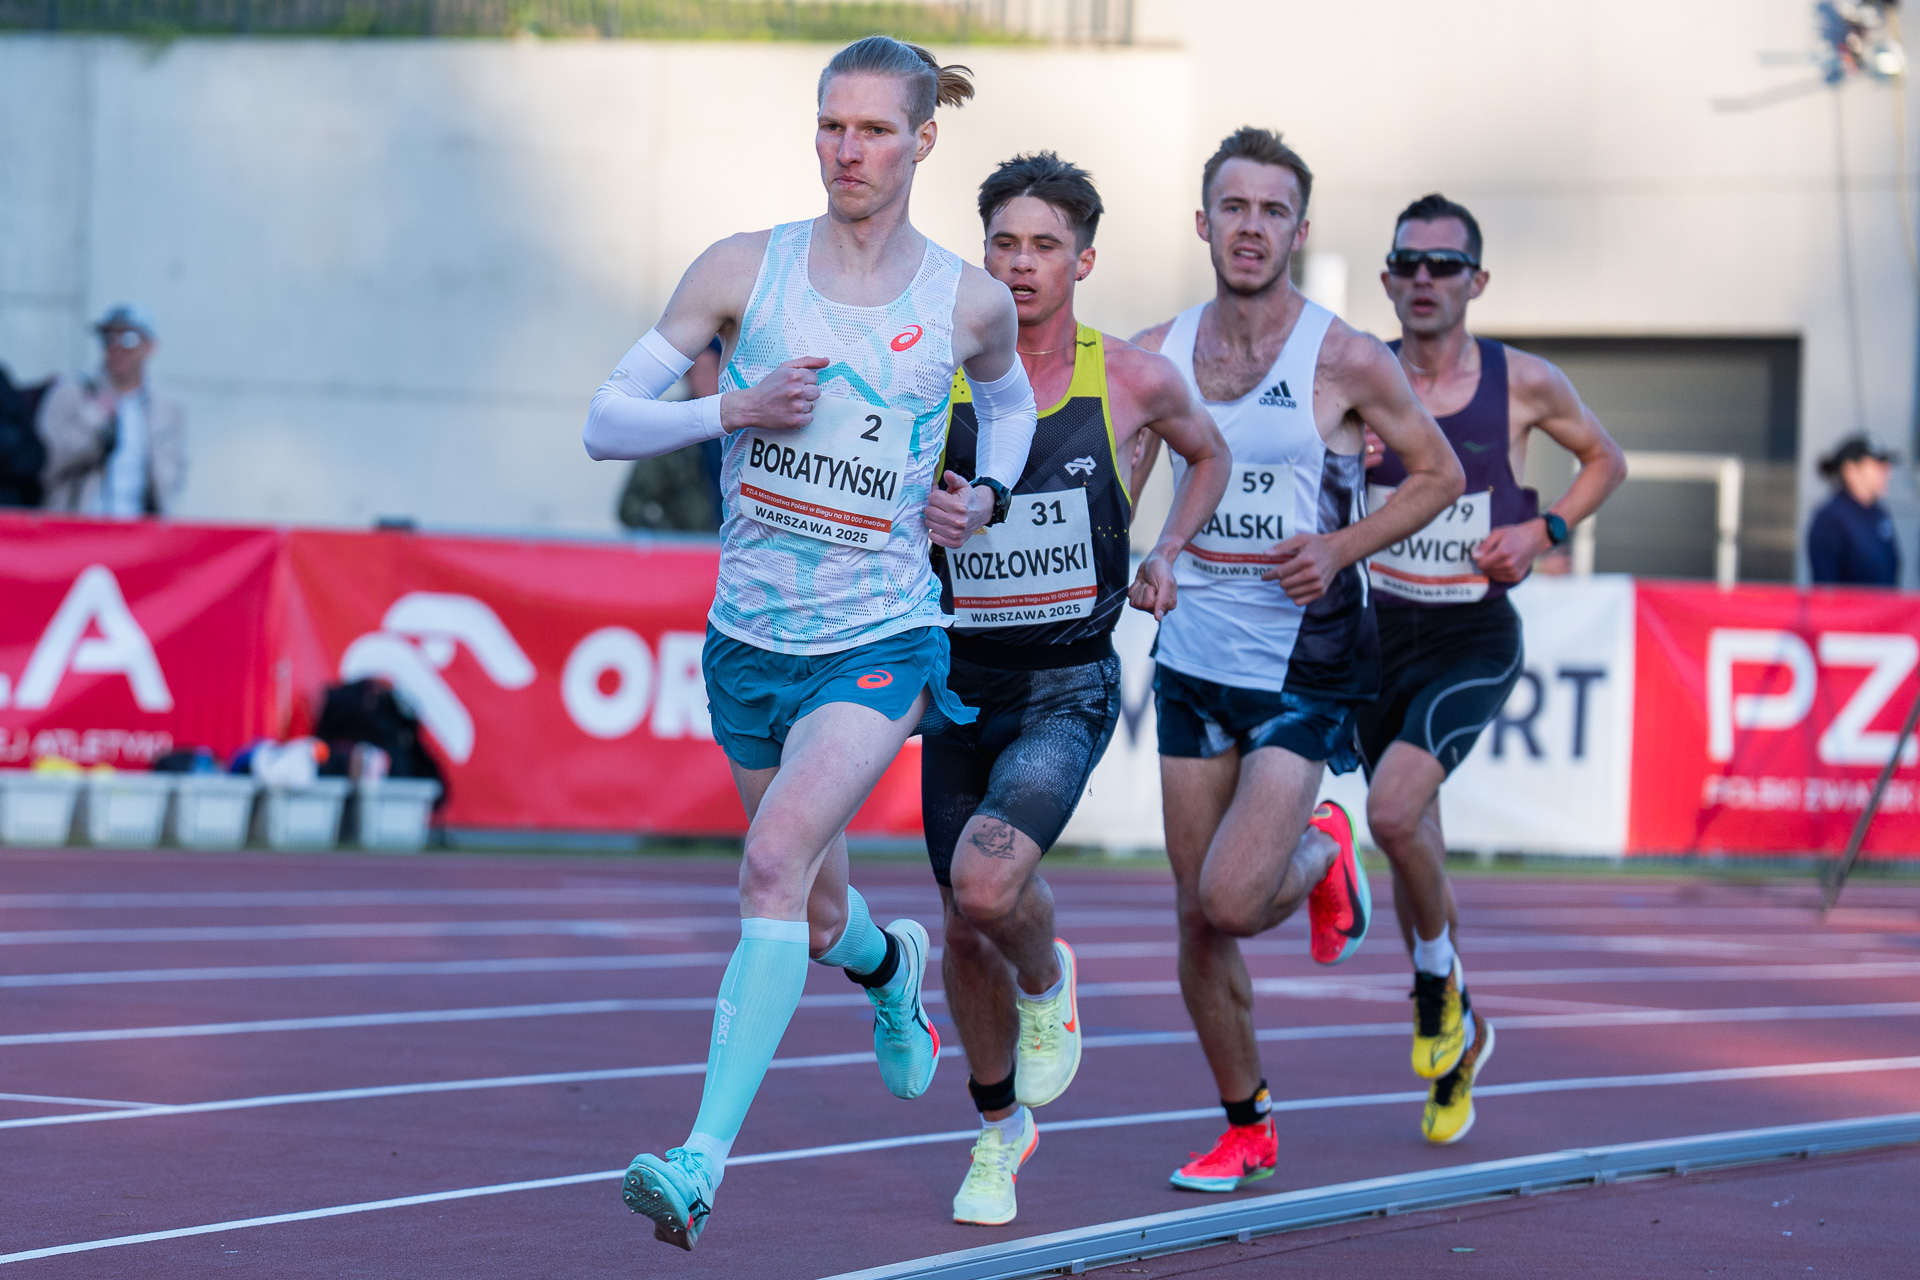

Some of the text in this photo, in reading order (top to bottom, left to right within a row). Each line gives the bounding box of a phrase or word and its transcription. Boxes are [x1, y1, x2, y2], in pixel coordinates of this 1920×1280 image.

[1259, 396, 1297, 409] adidas
[860, 414, 883, 442] 2
[750, 437, 897, 501] BORATYŃSKI
[1242, 471, 1275, 494] 59
[745, 487, 758, 496] PZLA
[759, 492, 790, 507] Mistrzostwa
[791, 502, 809, 511] Polski
[816, 508, 833, 517] Biegu
[851, 516, 863, 524] 000
[863, 519, 887, 528] metrów
[1031, 500, 1067, 526] 31
[755, 505, 869, 544] WARSZAWA 2025
[1202, 512, 1284, 540] ALSKI
[953, 542, 1088, 580] KOZŁOWSKI
[1386, 537, 1485, 562] OWICK
[1192, 558, 1273, 576] WARSZAWA 20
[1070, 589, 1093, 597] metrów
[971, 604, 1081, 623] WARSZAWA 2025
[0, 563, 175, 714] A
[716, 1014, 731, 1046] asics
